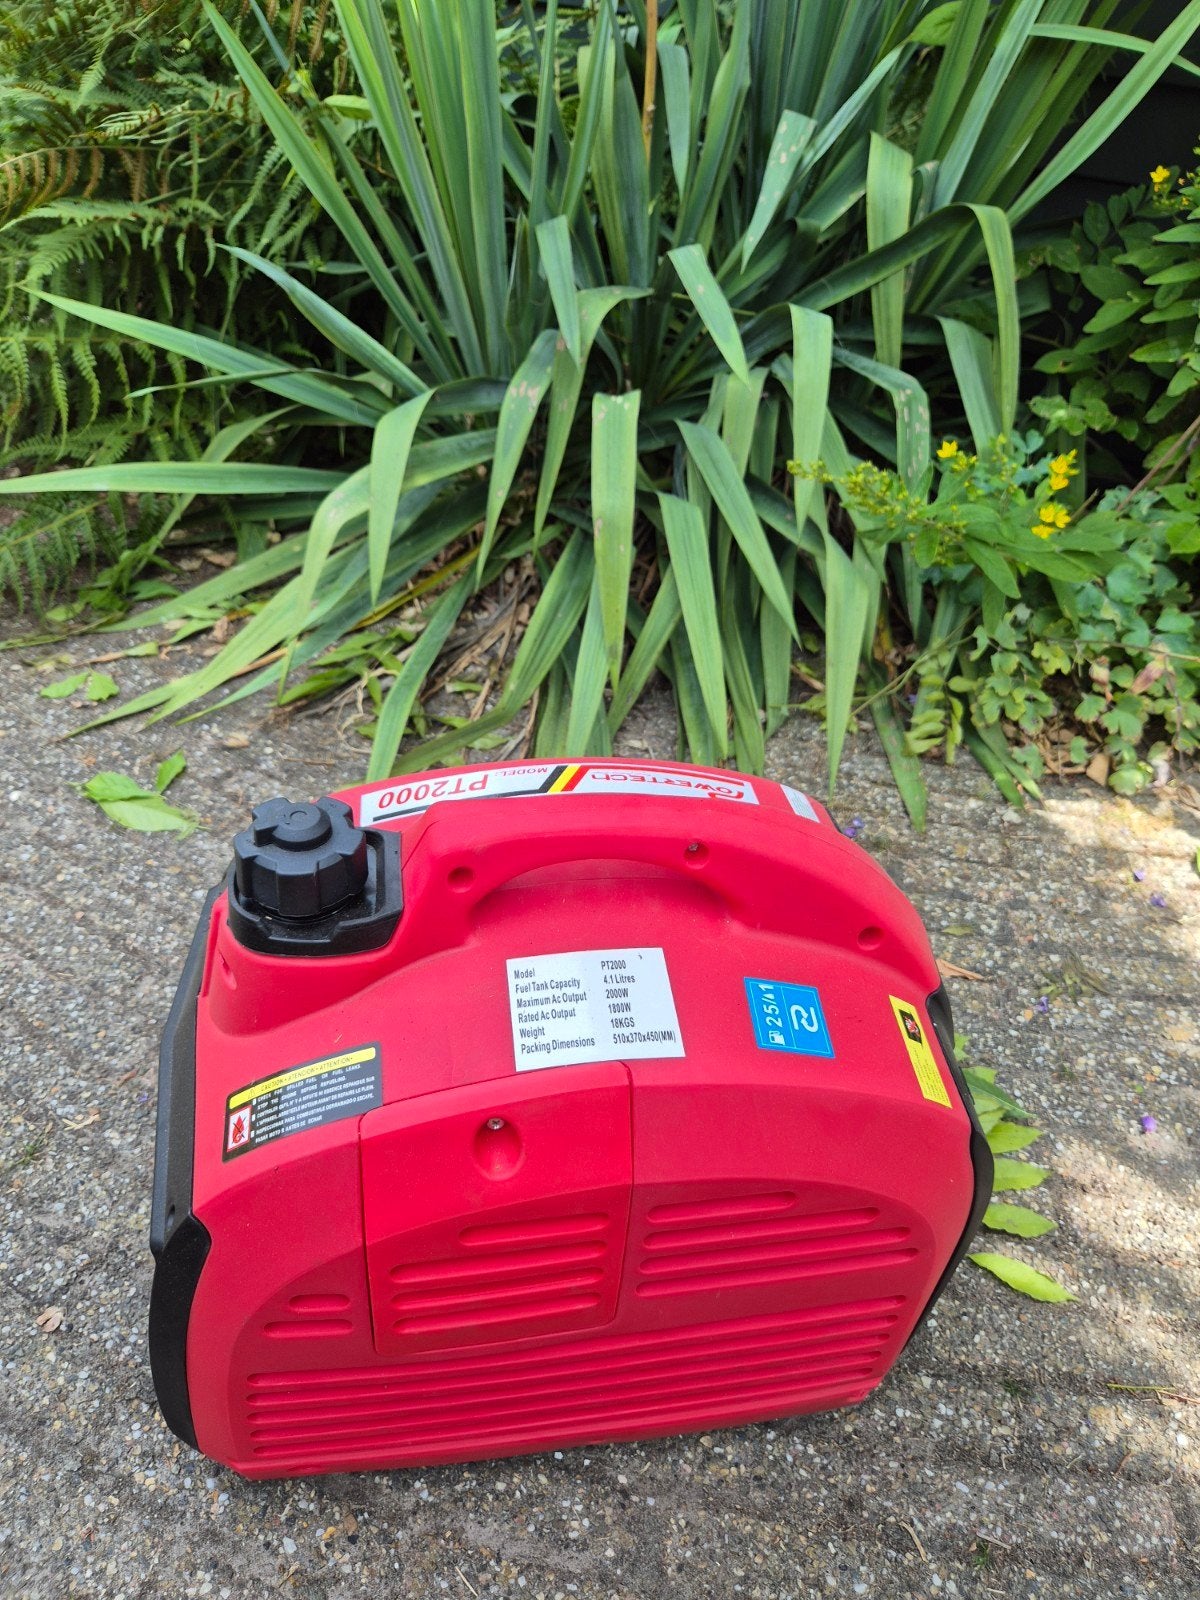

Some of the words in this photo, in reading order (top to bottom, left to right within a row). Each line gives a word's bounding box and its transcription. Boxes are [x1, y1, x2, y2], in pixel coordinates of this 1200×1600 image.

[494, 767, 548, 778] MODEL:
[378, 774, 489, 809] PT2000
[514, 968, 536, 979] Model
[600, 960, 627, 970] PT2000
[515, 983, 531, 994] Fuel
[532, 981, 549, 991] Tank
[549, 977, 581, 990] Capacity
[603, 974, 614, 984] 4.1
[615, 973, 636, 984] Litres
[516, 997, 551, 1008] Maximum
[552, 994, 561, 1004] Ac
[562, 991, 587, 1004] Output
[606, 988, 629, 999] 2000W
[518, 1011, 539, 1023] Rated
[540, 1010, 550, 1020] Ac
[551, 1007, 576, 1020] Output
[608, 1002, 631, 1013] 1800W
[519, 1026, 545, 1039] Weight
[610, 1017, 635, 1028] 18KGS
[521, 1041, 551, 1054] Packing
[551, 1037, 596, 1050] Dimensions
[613, 1030, 676, 1044] 510x370x450(MM)
